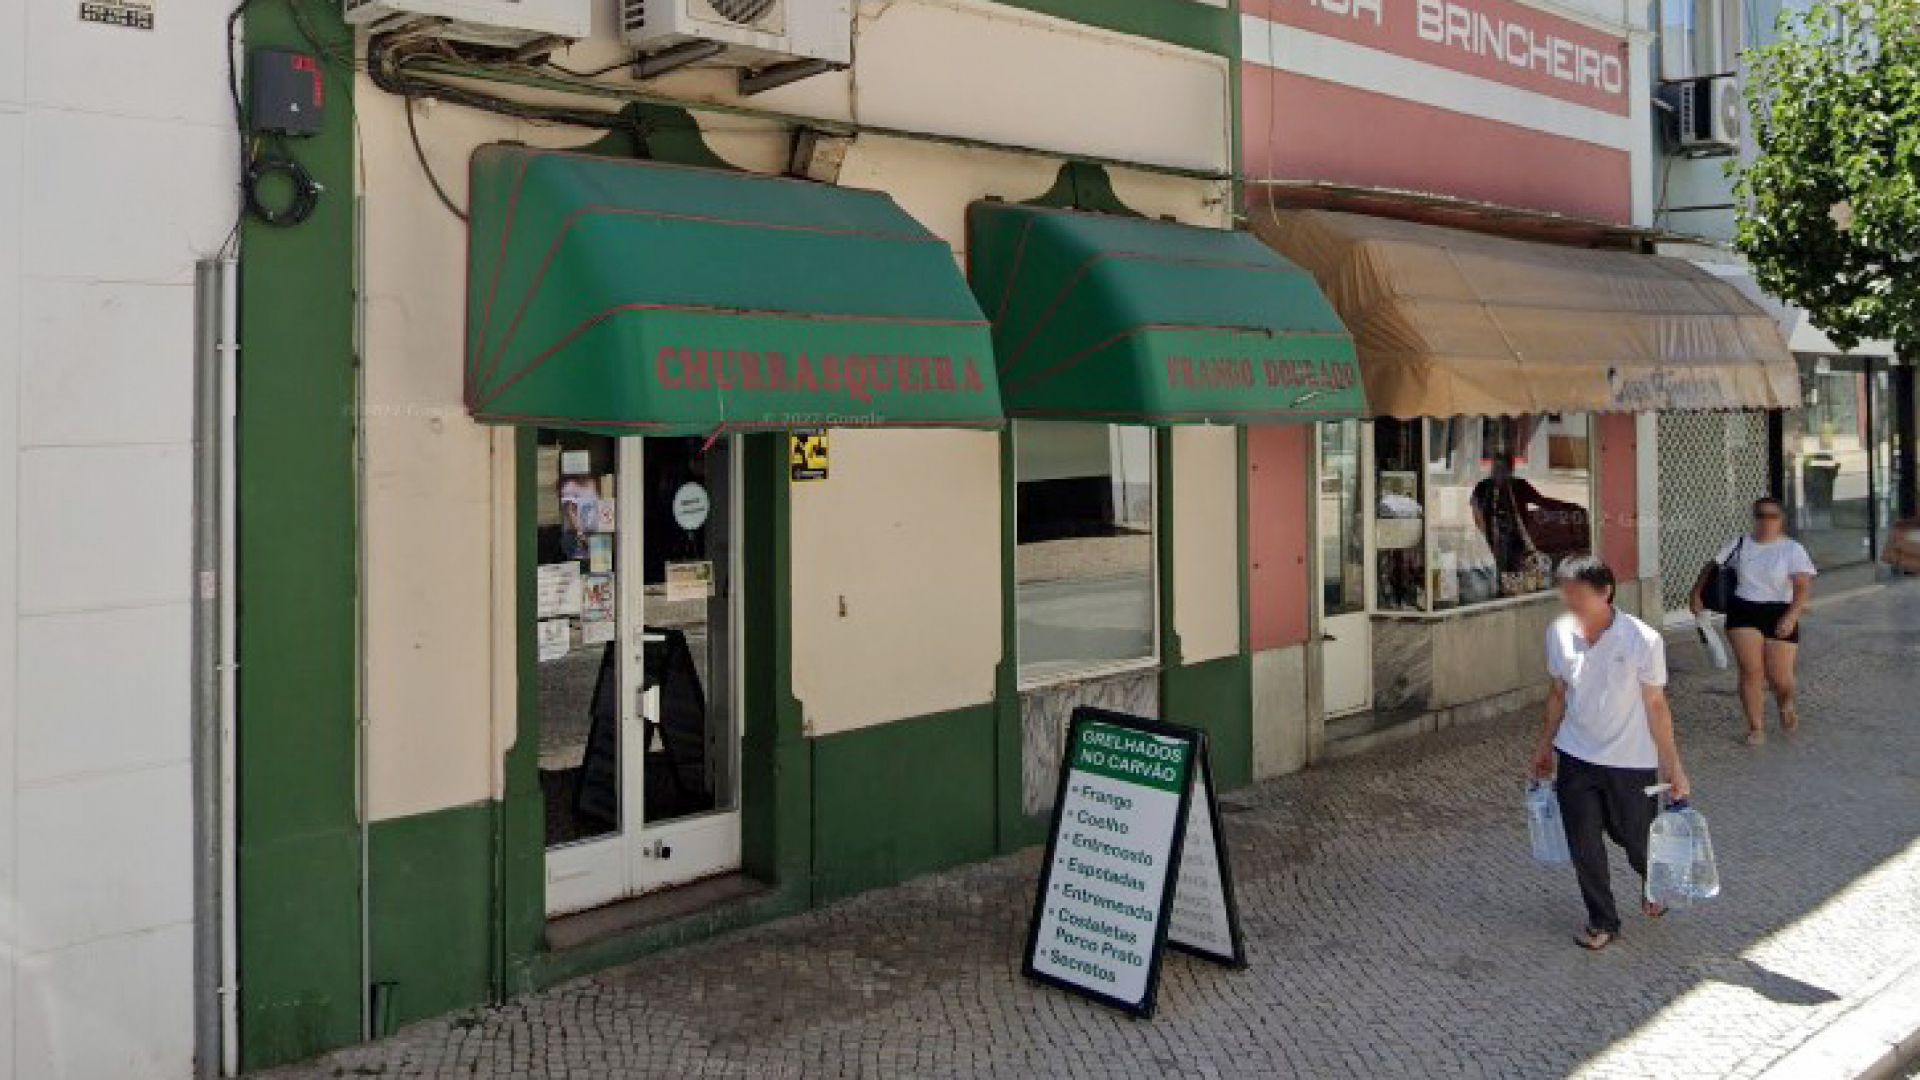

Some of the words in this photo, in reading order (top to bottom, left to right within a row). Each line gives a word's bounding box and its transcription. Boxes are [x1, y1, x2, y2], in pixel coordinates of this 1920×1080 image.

[1416, 0, 1622, 94] BRINCHEIRO
[656, 346, 984, 405] CHURRASQUEIRA
[1166, 355, 1254, 391] FRANGO
[1082, 729, 1182, 762] GRELHADOS
[1080, 748, 1105, 766] NO
[1107, 753, 1177, 782] CARVÃO
[1082, 785, 1132, 811] Frango
[1077, 809, 1129, 835] Coelho
[1072, 833, 1153, 867] Entrecosto
[1067, 857, 1145, 893] Espetadas
[1062, 883, 1153, 922] Entremeada
[1056, 926, 1098, 952] Porco
[1050, 950, 1116, 983] Secretos
